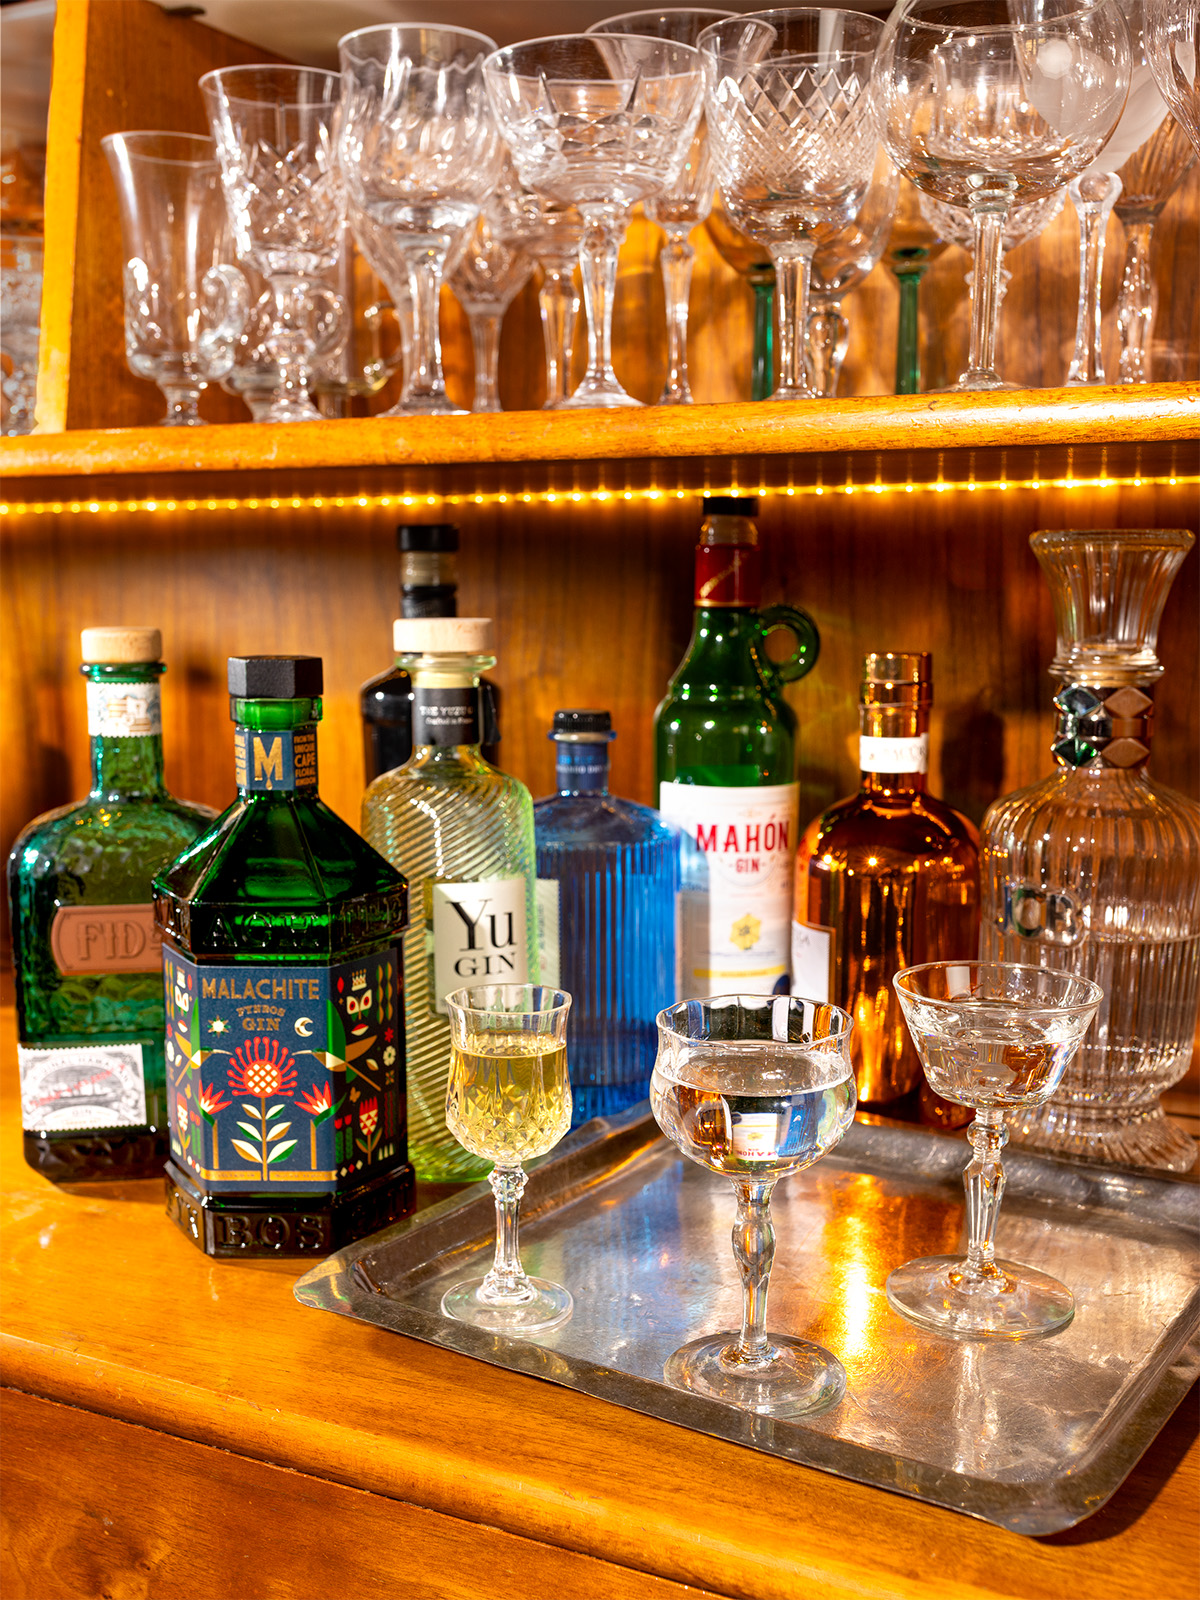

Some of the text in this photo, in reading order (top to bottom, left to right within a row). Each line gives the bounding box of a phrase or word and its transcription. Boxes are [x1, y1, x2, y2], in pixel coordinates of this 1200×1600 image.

[253, 736, 283, 781] M
[294, 752, 316, 768] CAPE
[696, 813, 789, 853] MAHÓN
[736, 858, 760, 873] GIN
[445, 898, 517, 952] Yu
[454, 951, 516, 978] GIN
[202, 977, 320, 1000] MALACHITE
[236, 1004, 286, 1017] FYNBOS
[242, 1017, 281, 1031] GIN
[217, 1214, 325, 1250] BOS
